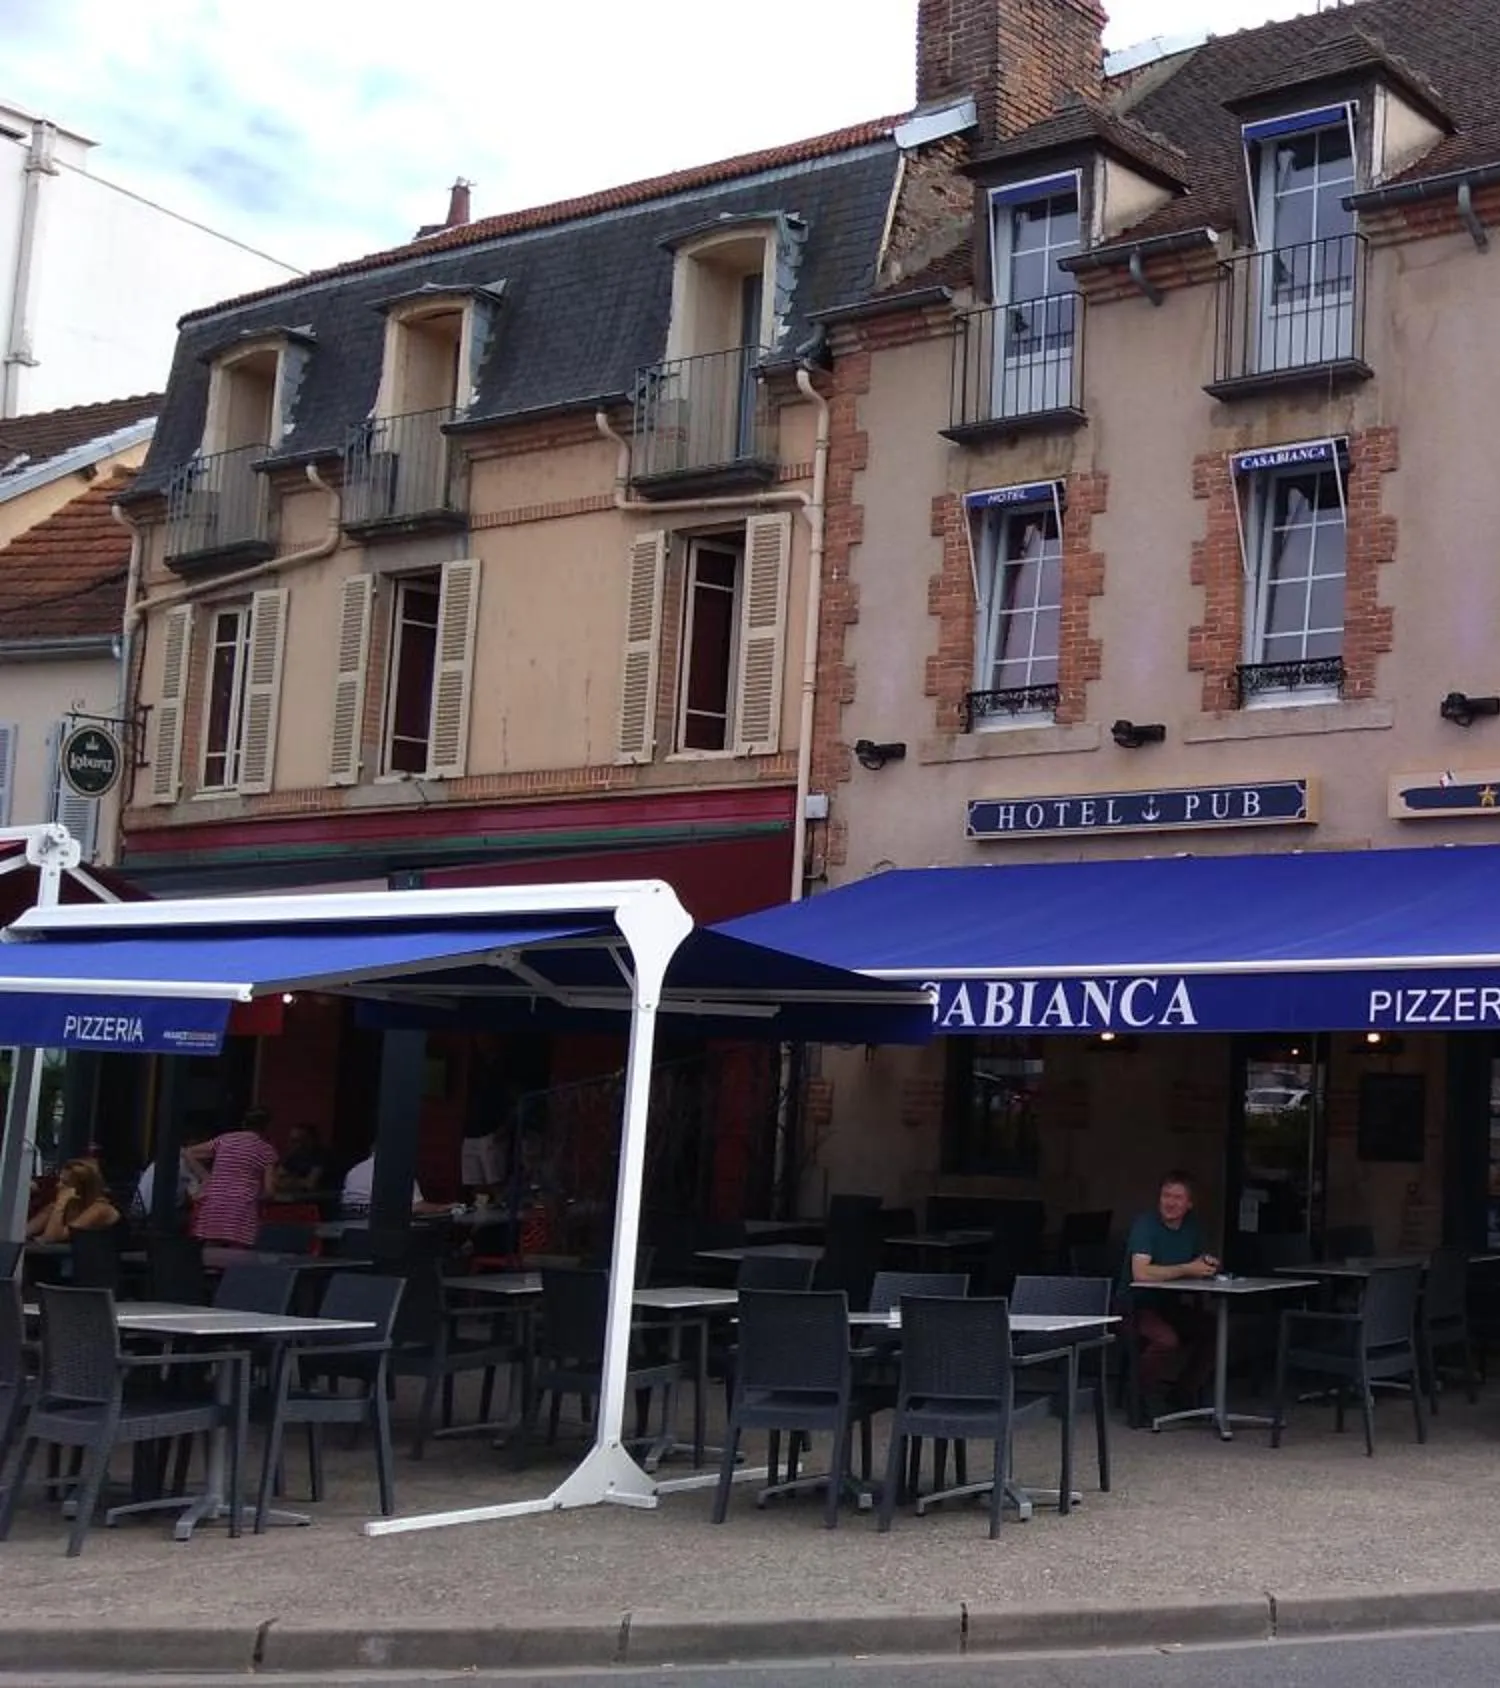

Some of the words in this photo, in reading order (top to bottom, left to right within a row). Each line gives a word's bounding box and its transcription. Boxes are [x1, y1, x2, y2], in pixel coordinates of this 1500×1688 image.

[1241, 447, 1326, 469] CASABIANCA
[987, 489, 1029, 504] HOTEL
[998, 799, 1123, 829] HOTEL
[1184, 791, 1261, 819] PUB
[63, 1015, 145, 1043] PIZZERIA
